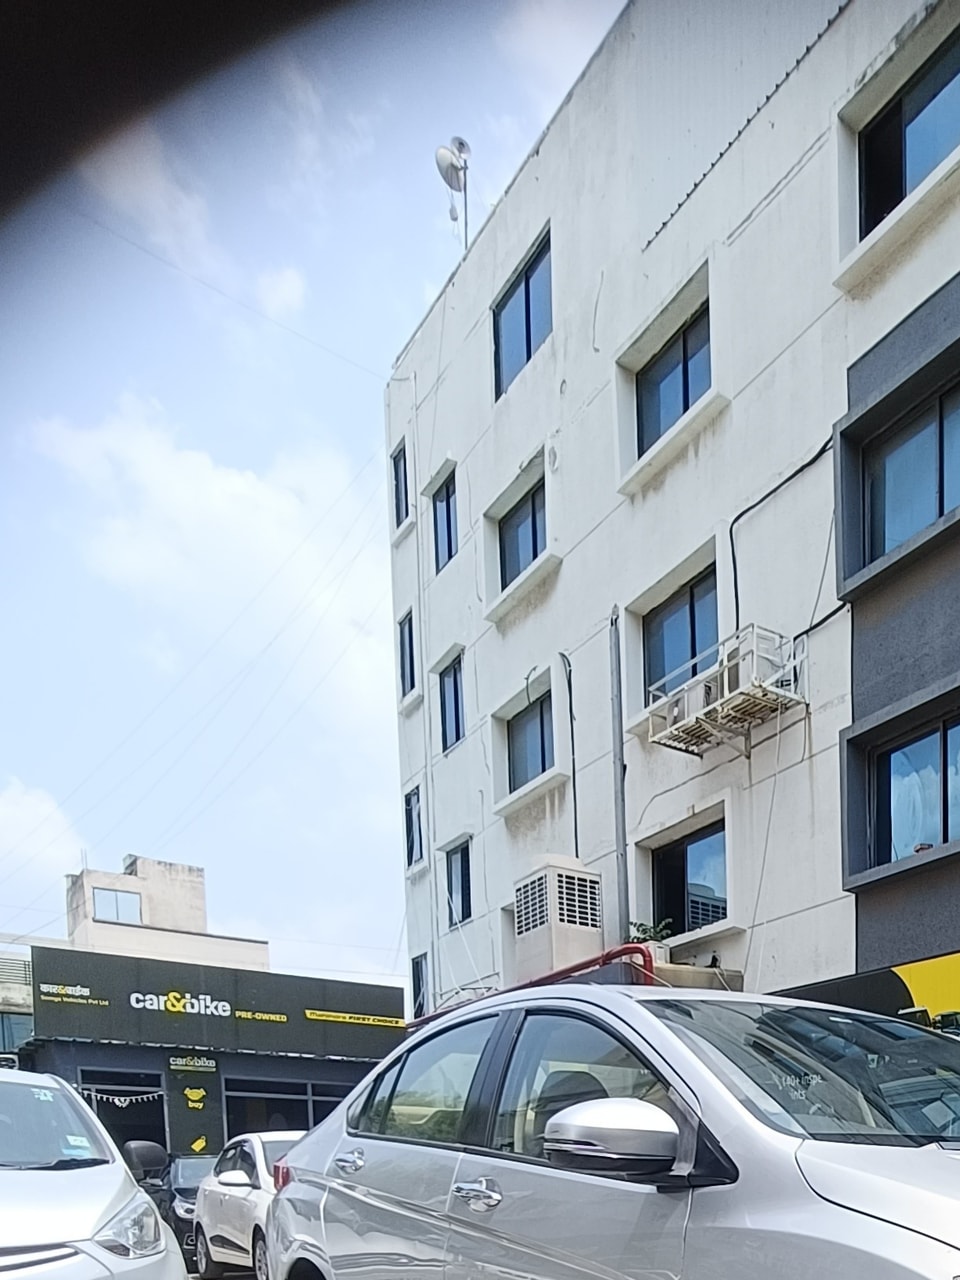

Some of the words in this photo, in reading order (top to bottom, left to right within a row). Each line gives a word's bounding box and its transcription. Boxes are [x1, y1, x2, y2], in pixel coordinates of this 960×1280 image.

[129, 991, 231, 1017] car&bike
[234, 1009, 288, 1023] PRE-OWNED
[169, 1056, 216, 1068] car&bike
[188, 1100, 204, 1110] buy
